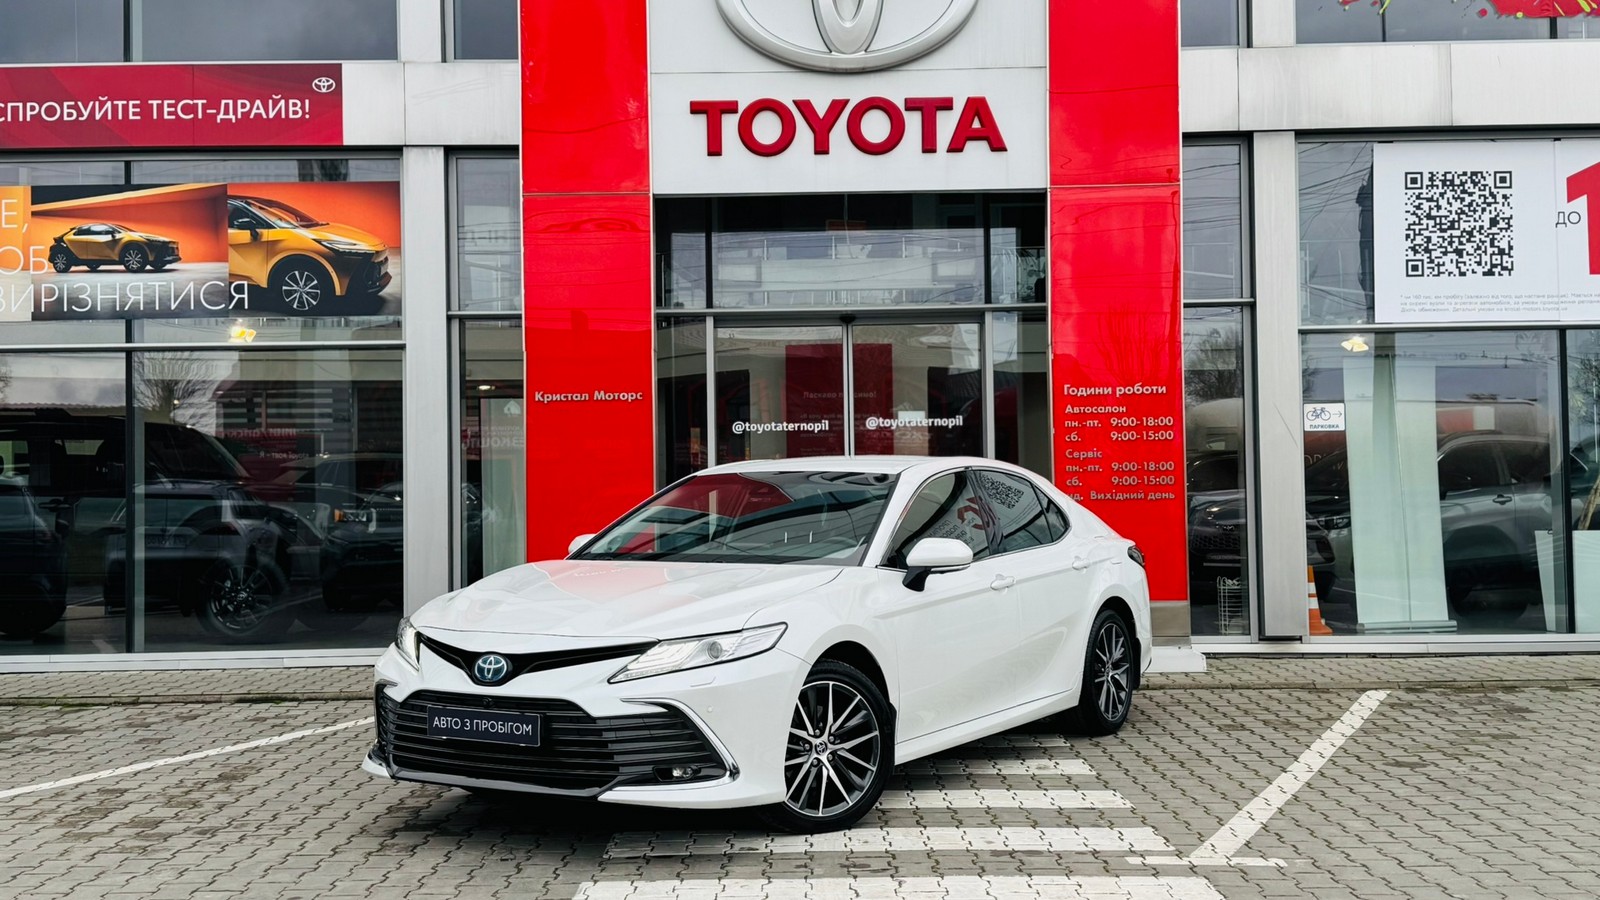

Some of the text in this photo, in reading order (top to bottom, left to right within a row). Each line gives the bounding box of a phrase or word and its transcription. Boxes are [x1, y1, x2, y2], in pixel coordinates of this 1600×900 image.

[147, 94, 311, 123] ТЕСТ-ДРАЙВ!
[689, 95, 1008, 157] TOYOTA
[534, 390, 643, 404] Кристал Моторс
[1063, 382, 1167, 398] Години роботи
[1064, 404, 1126, 414] Автосалон
[732, 419, 829, 435] @toyotaternopil
[865, 415, 963, 431] @toyotaternopil
[1065, 431, 1081, 441] сб.
[1065, 447, 1103, 460] Сервіс
[1066, 476, 1082, 486] сб.
[1090, 489, 1145, 501] Вихідний
[1147, 491, 1175, 500] день
[432, 716, 532, 736] АВТО З ПРОБІГОМ
